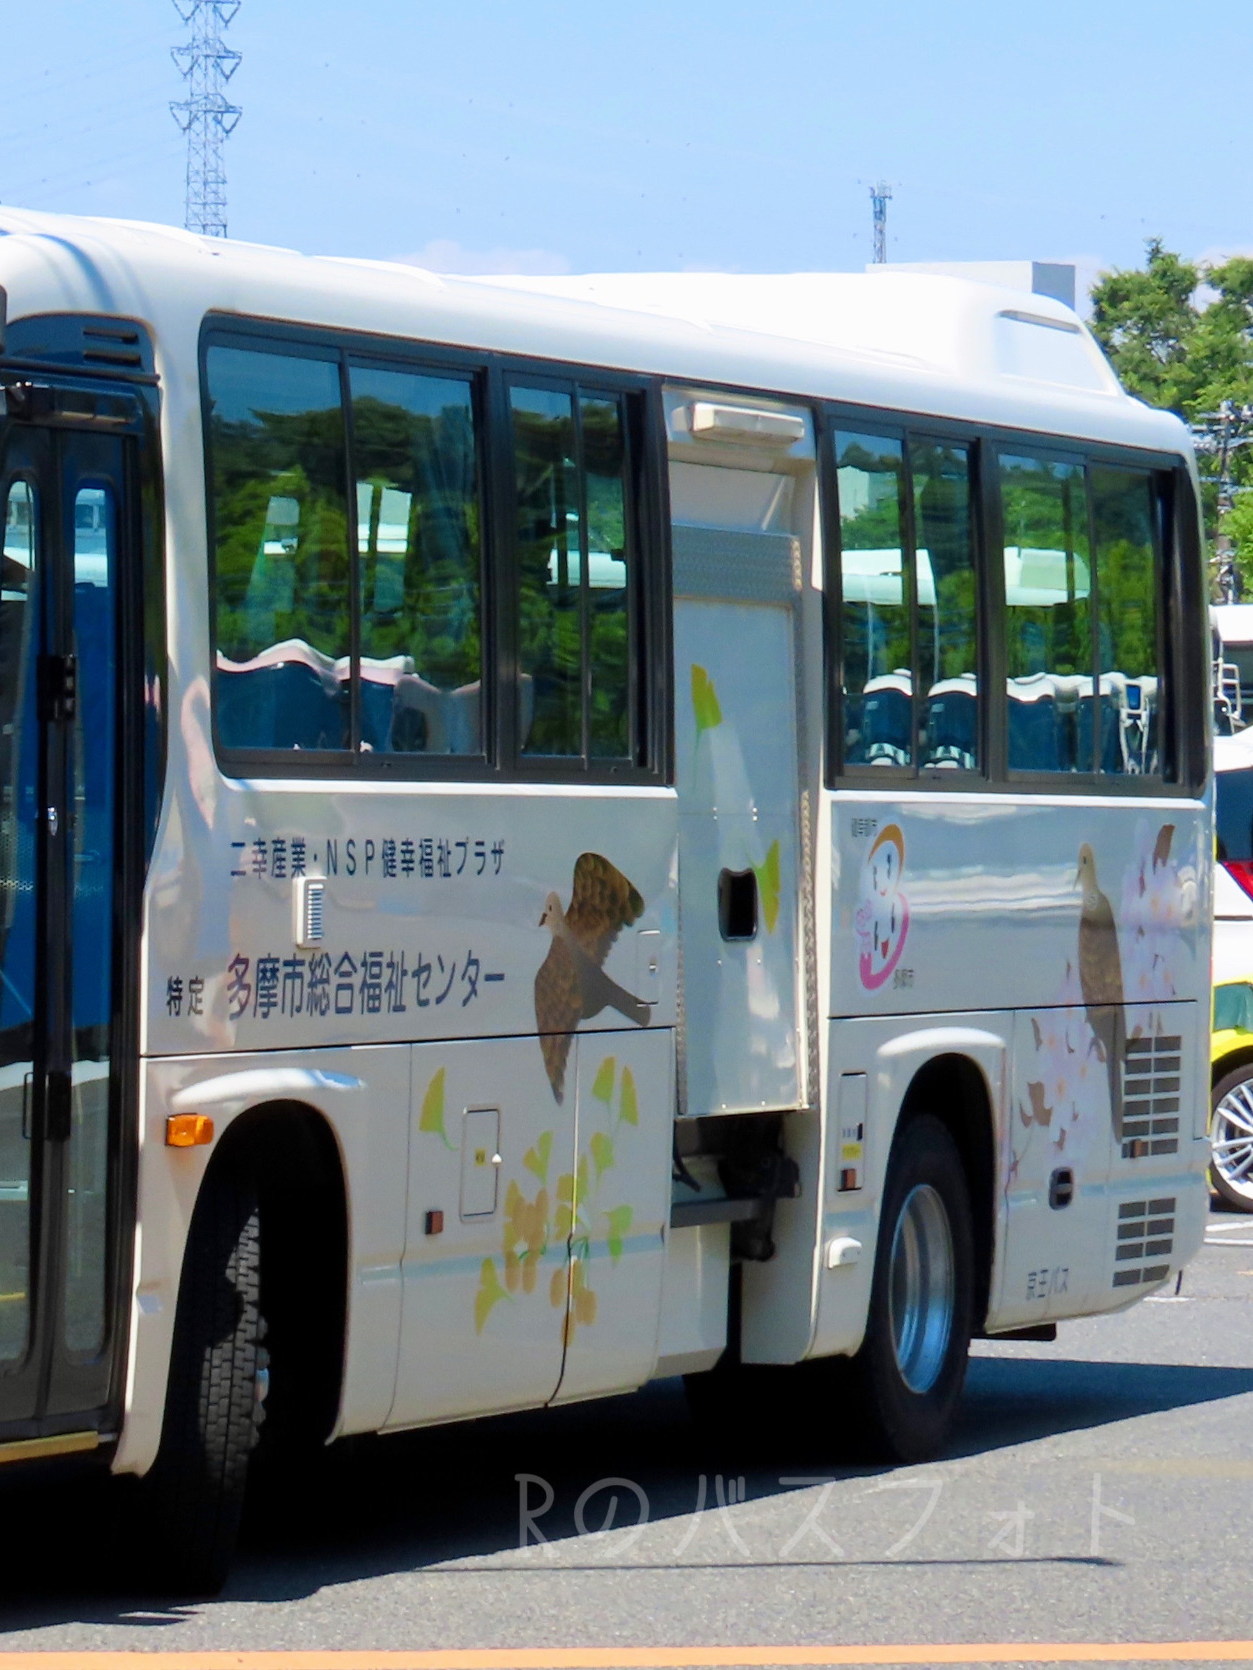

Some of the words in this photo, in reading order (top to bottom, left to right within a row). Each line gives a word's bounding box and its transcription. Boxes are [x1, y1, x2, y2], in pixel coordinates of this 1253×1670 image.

[166, 975, 205, 1017] 特定
[227, 949, 506, 1021] 多摩市総合福祉センター
